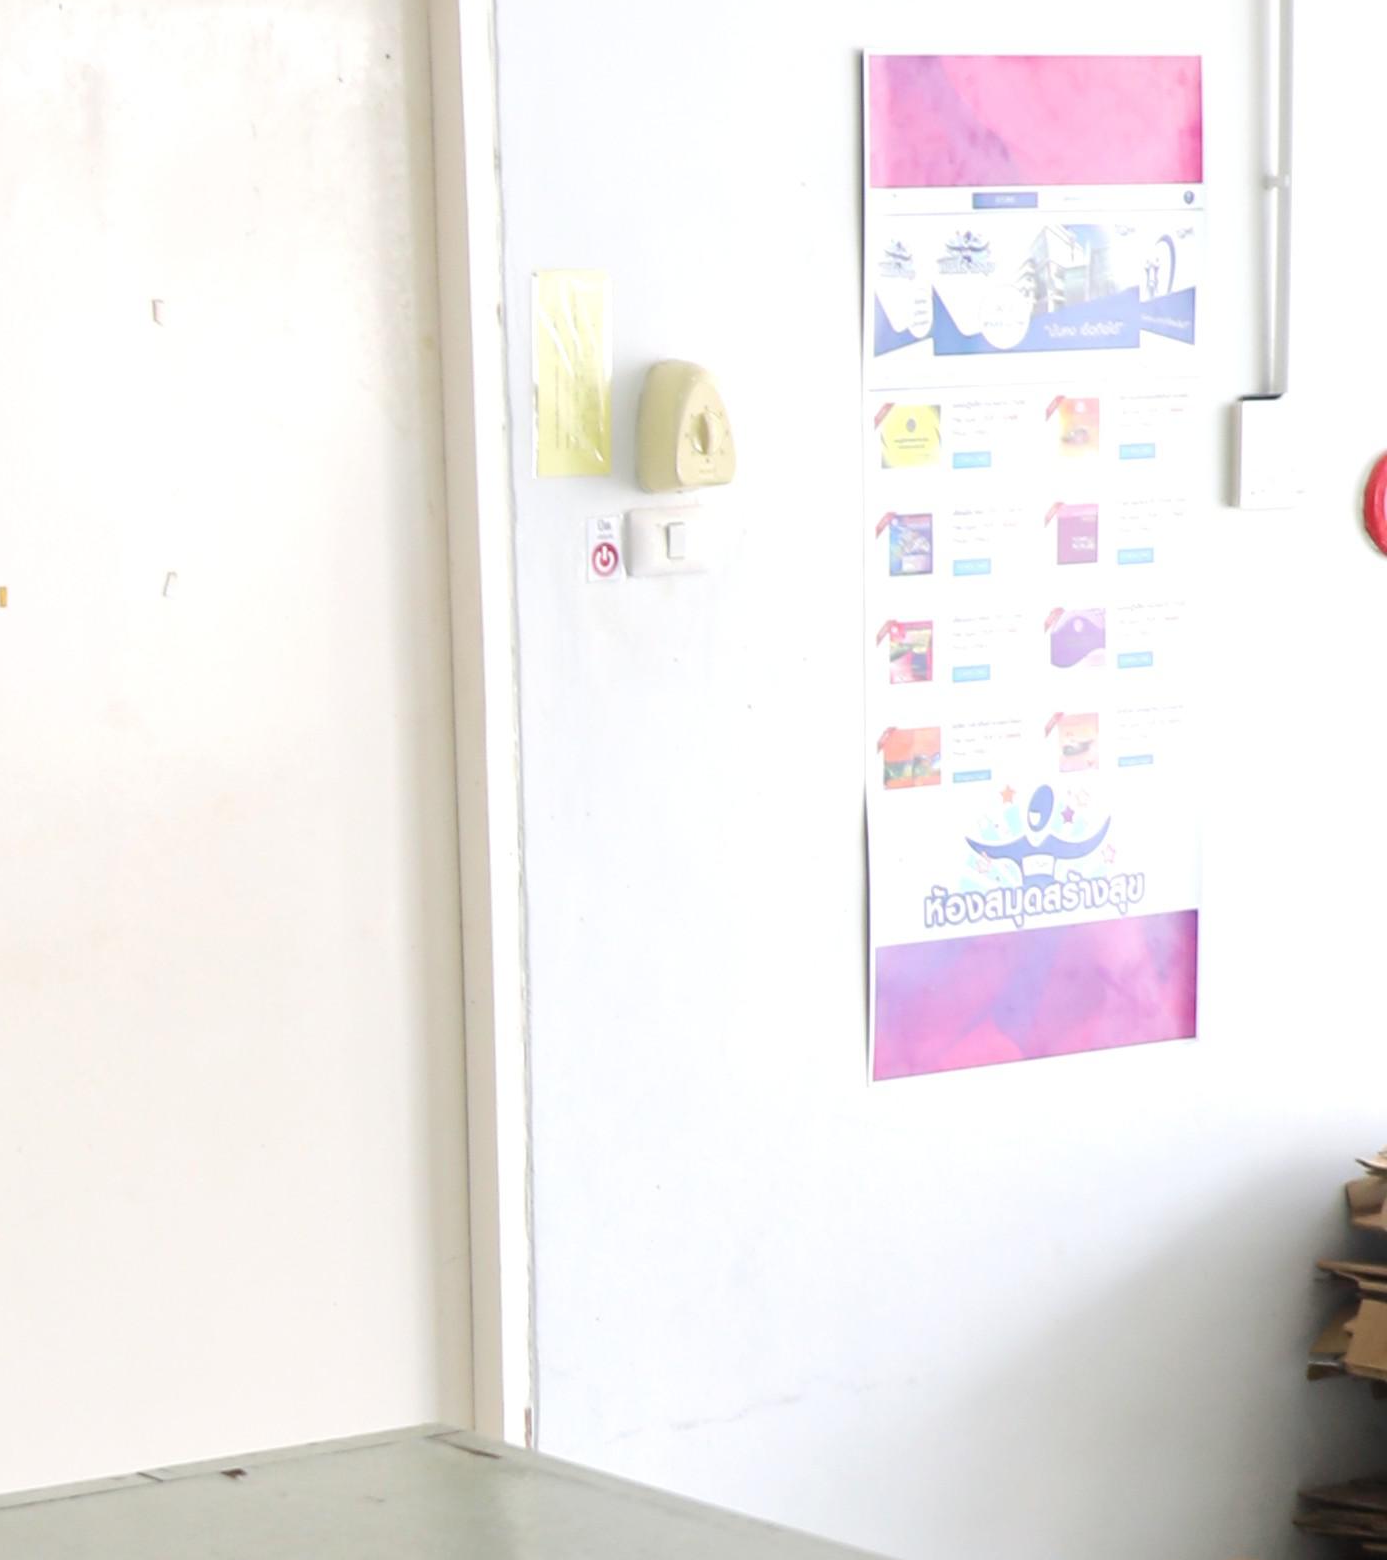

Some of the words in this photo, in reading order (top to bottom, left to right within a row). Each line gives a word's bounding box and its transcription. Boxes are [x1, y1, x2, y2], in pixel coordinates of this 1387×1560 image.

[924, 868, 1146, 929] ห้องสมุดสร้างสุข
